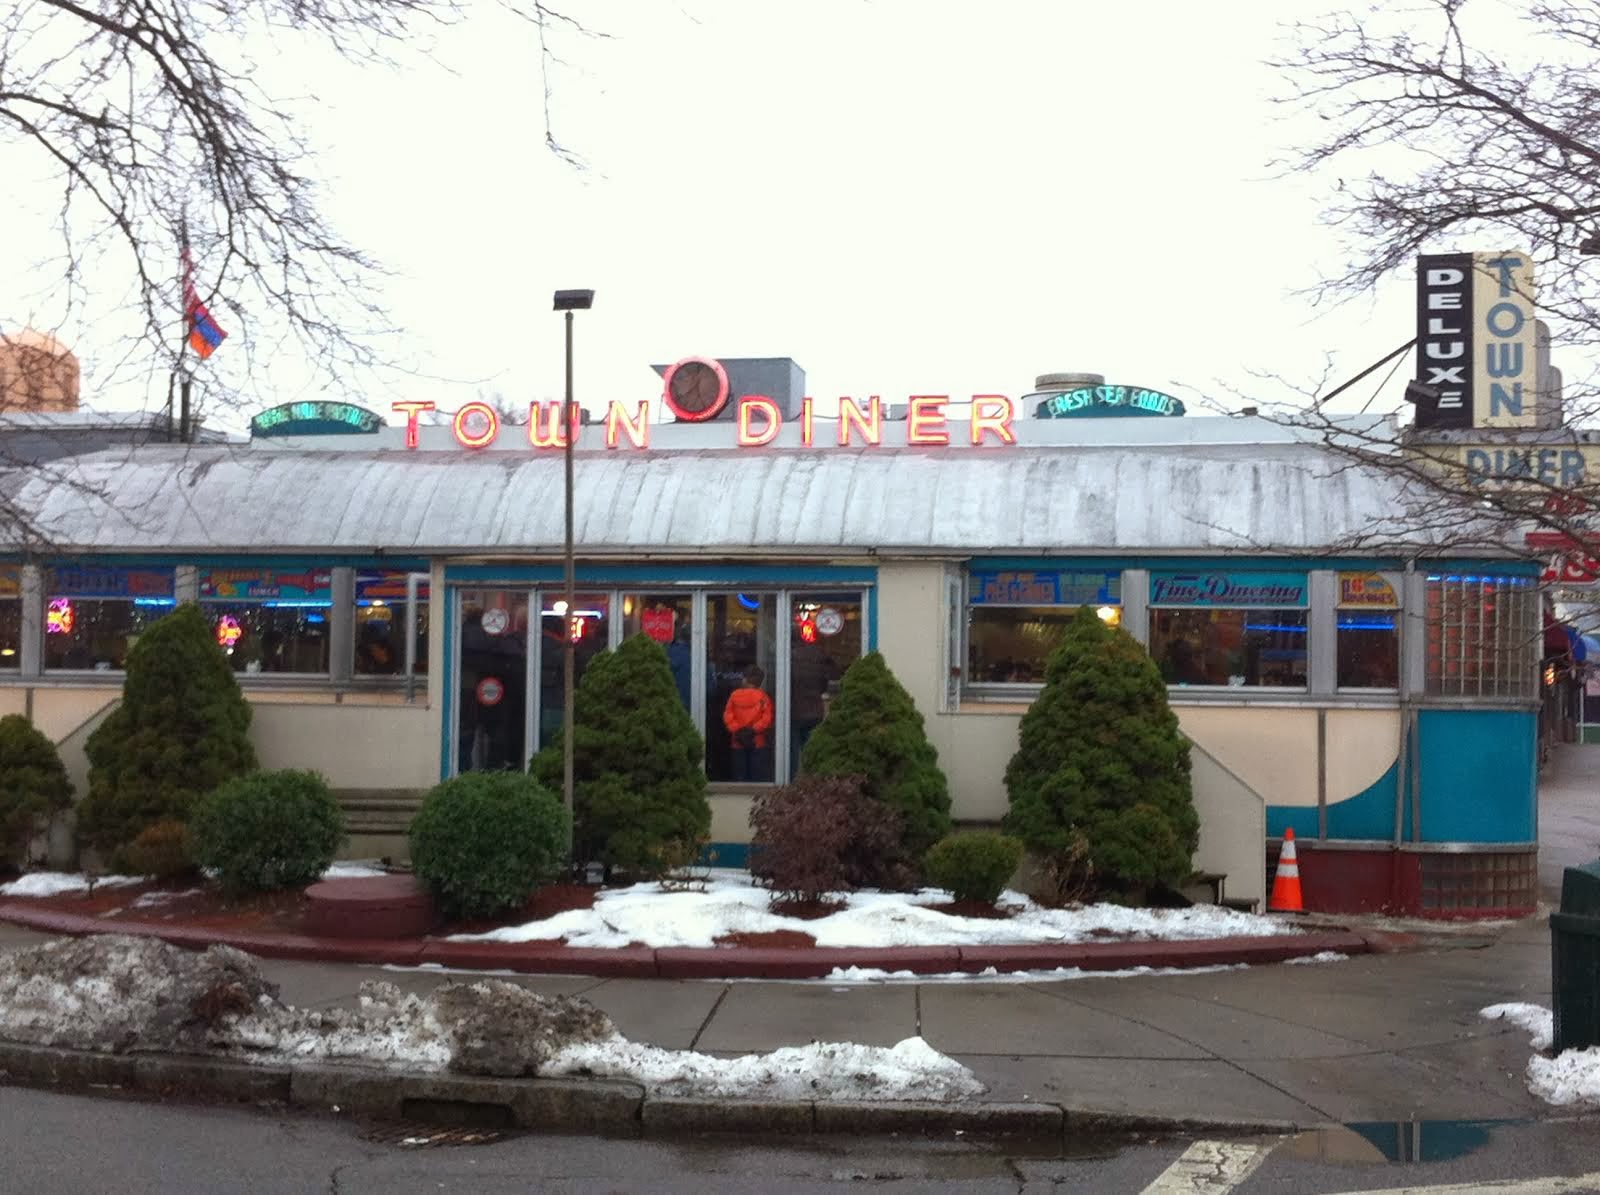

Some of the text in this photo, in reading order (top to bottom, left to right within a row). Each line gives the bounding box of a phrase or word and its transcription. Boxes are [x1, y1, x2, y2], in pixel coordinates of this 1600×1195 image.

[1426, 268, 1466, 408] DELUXE
[1486, 257, 1525, 417] TOWN
[391, 394, 1017, 450] TOWN DINER
[1046, 389, 1093, 417] FRESH
[1466, 448, 1586, 487] DINER
